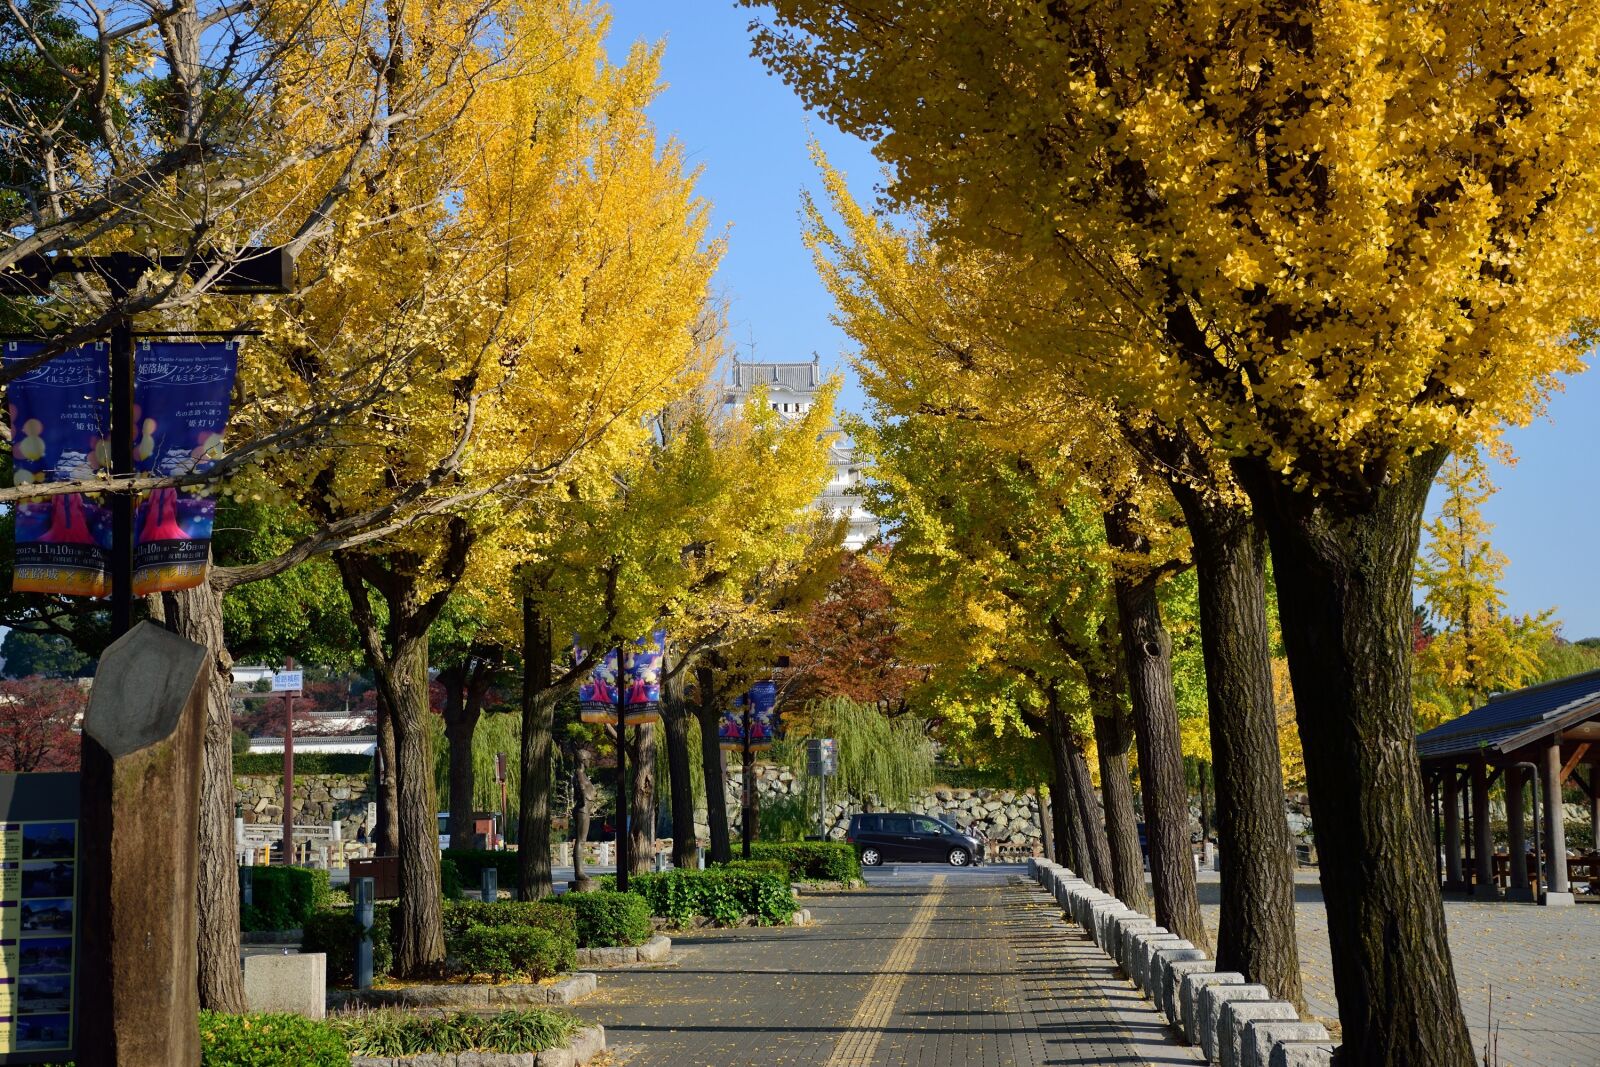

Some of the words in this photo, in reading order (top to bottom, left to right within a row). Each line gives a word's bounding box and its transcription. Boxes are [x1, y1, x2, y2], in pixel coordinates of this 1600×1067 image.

[44, 375, 96, 383] イルミネーション
[168, 373, 221, 382] イルミネーション
